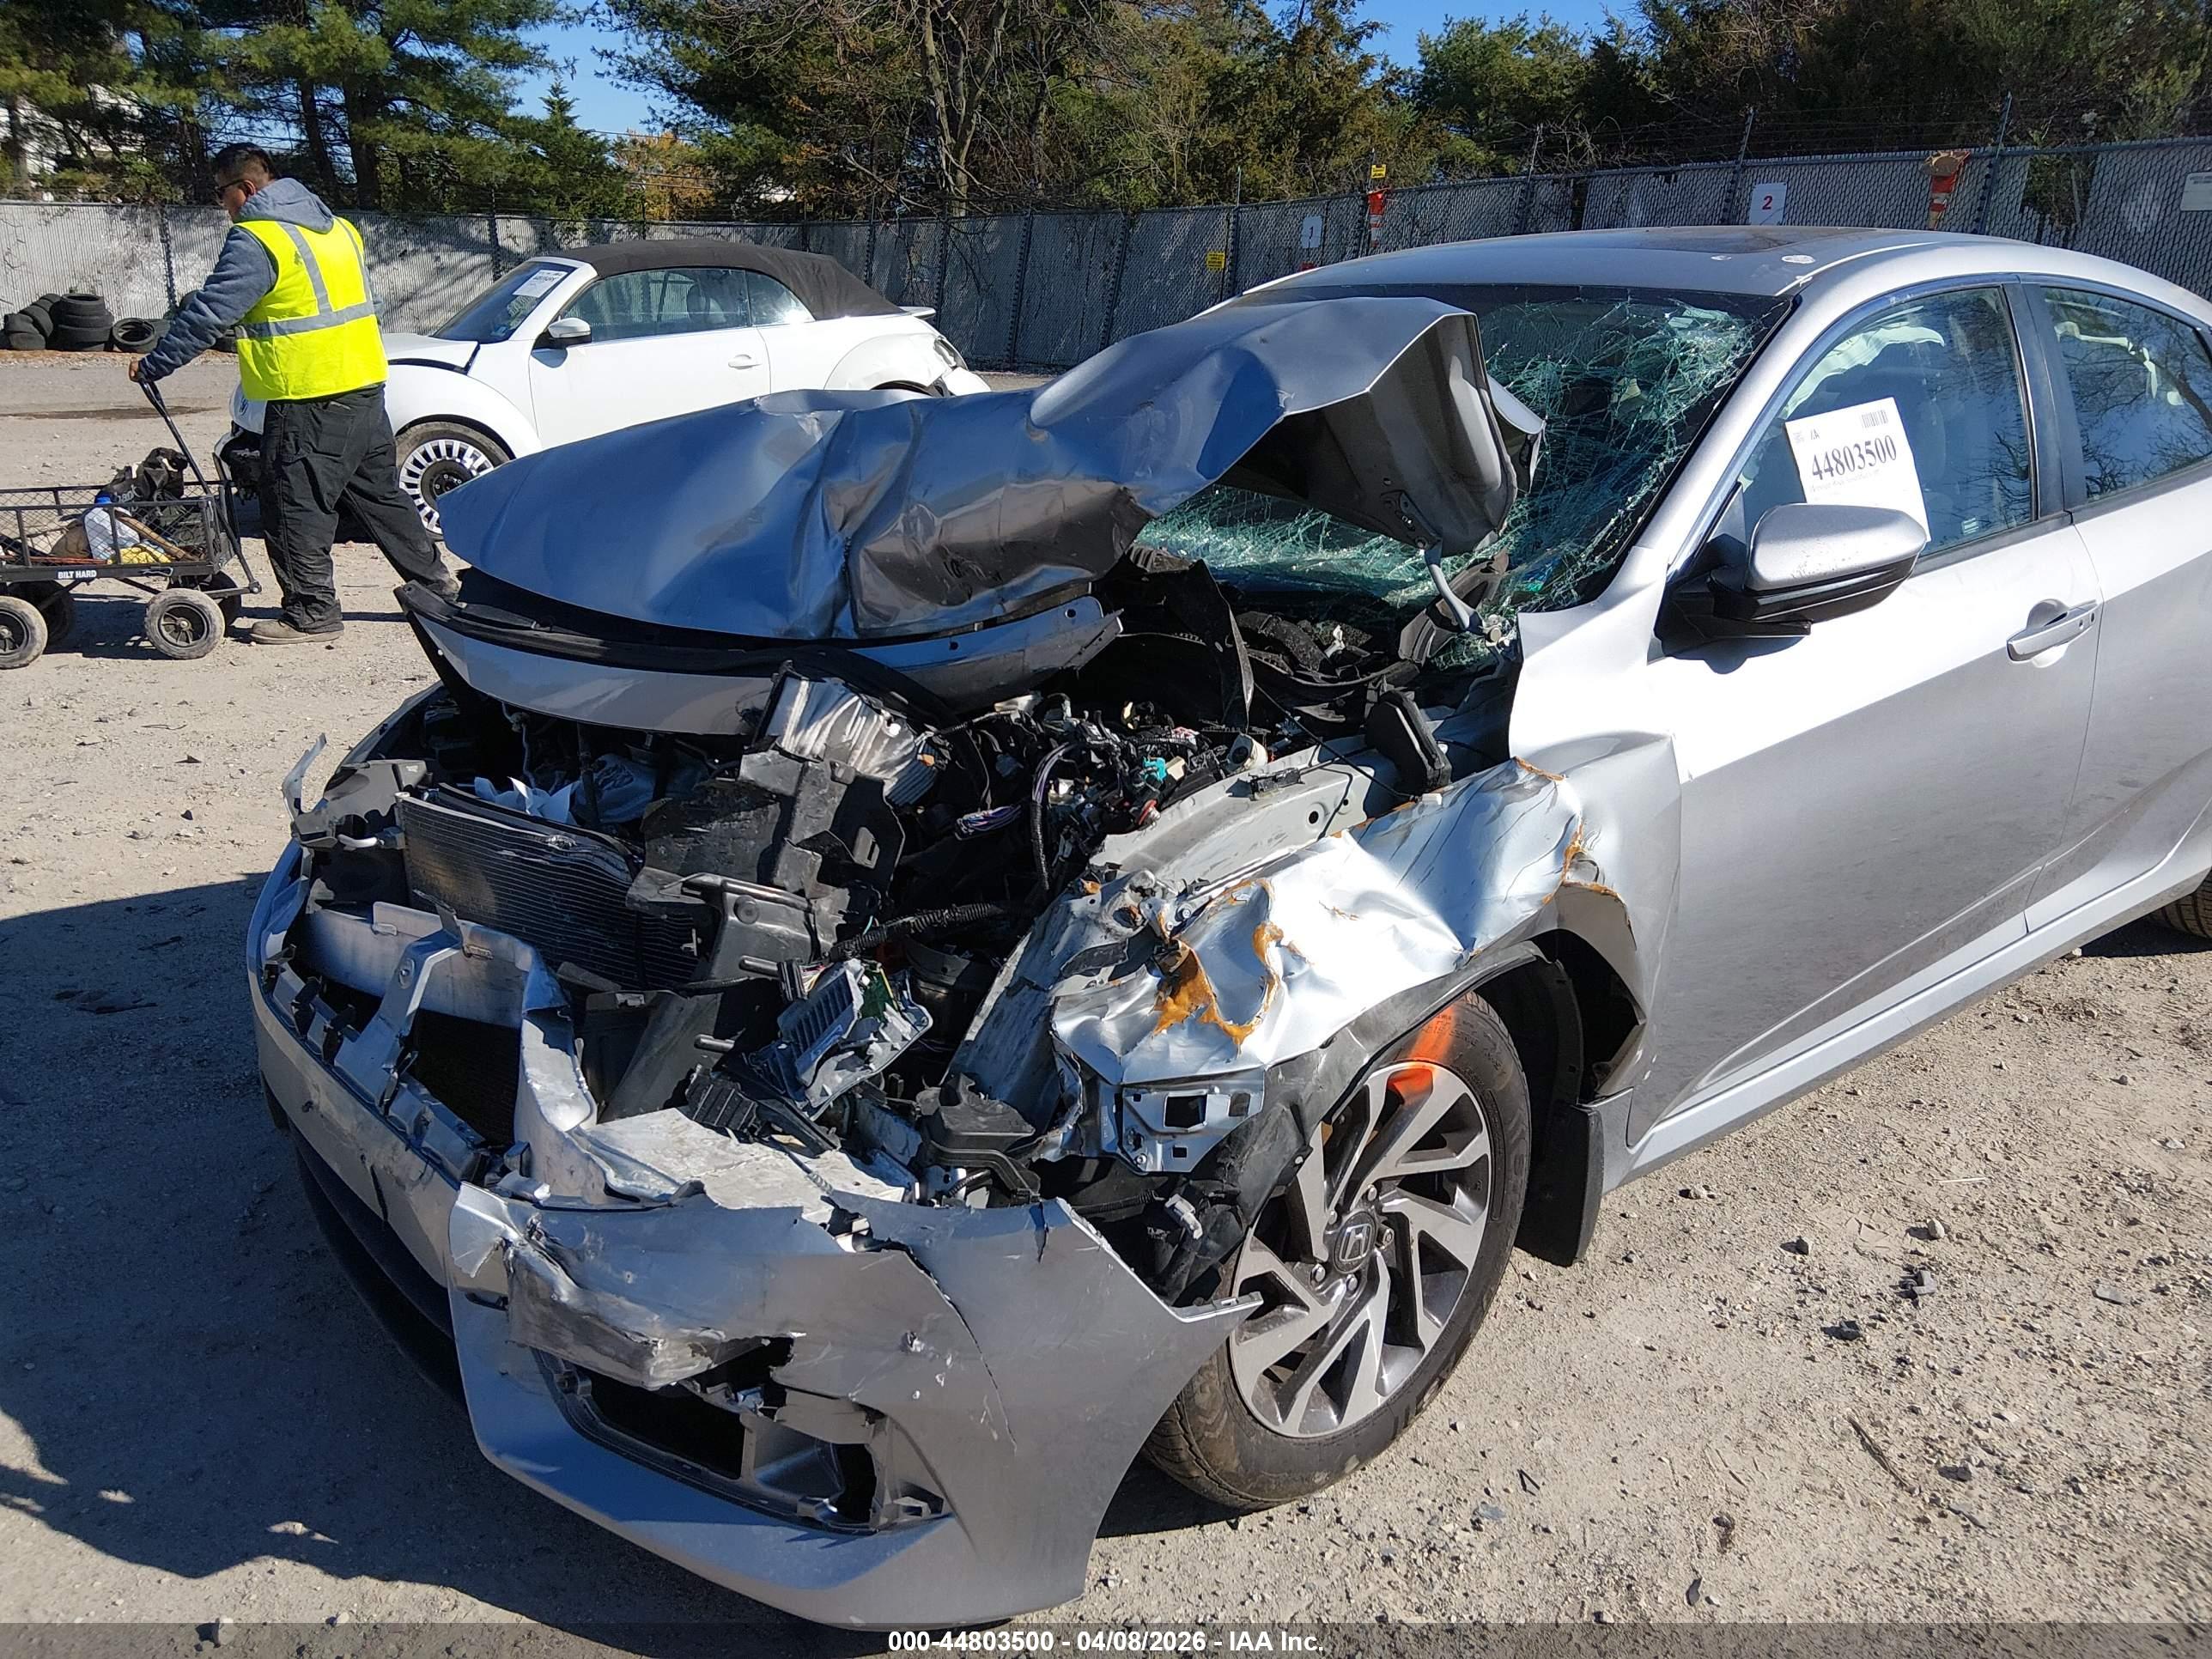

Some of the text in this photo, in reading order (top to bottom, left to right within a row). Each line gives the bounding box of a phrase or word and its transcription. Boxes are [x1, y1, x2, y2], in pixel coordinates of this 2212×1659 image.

[1762, 195, 1773, 210] 2
[1812, 434, 1897, 480] 44803500
[58, 569, 98, 580] BILT HARD
